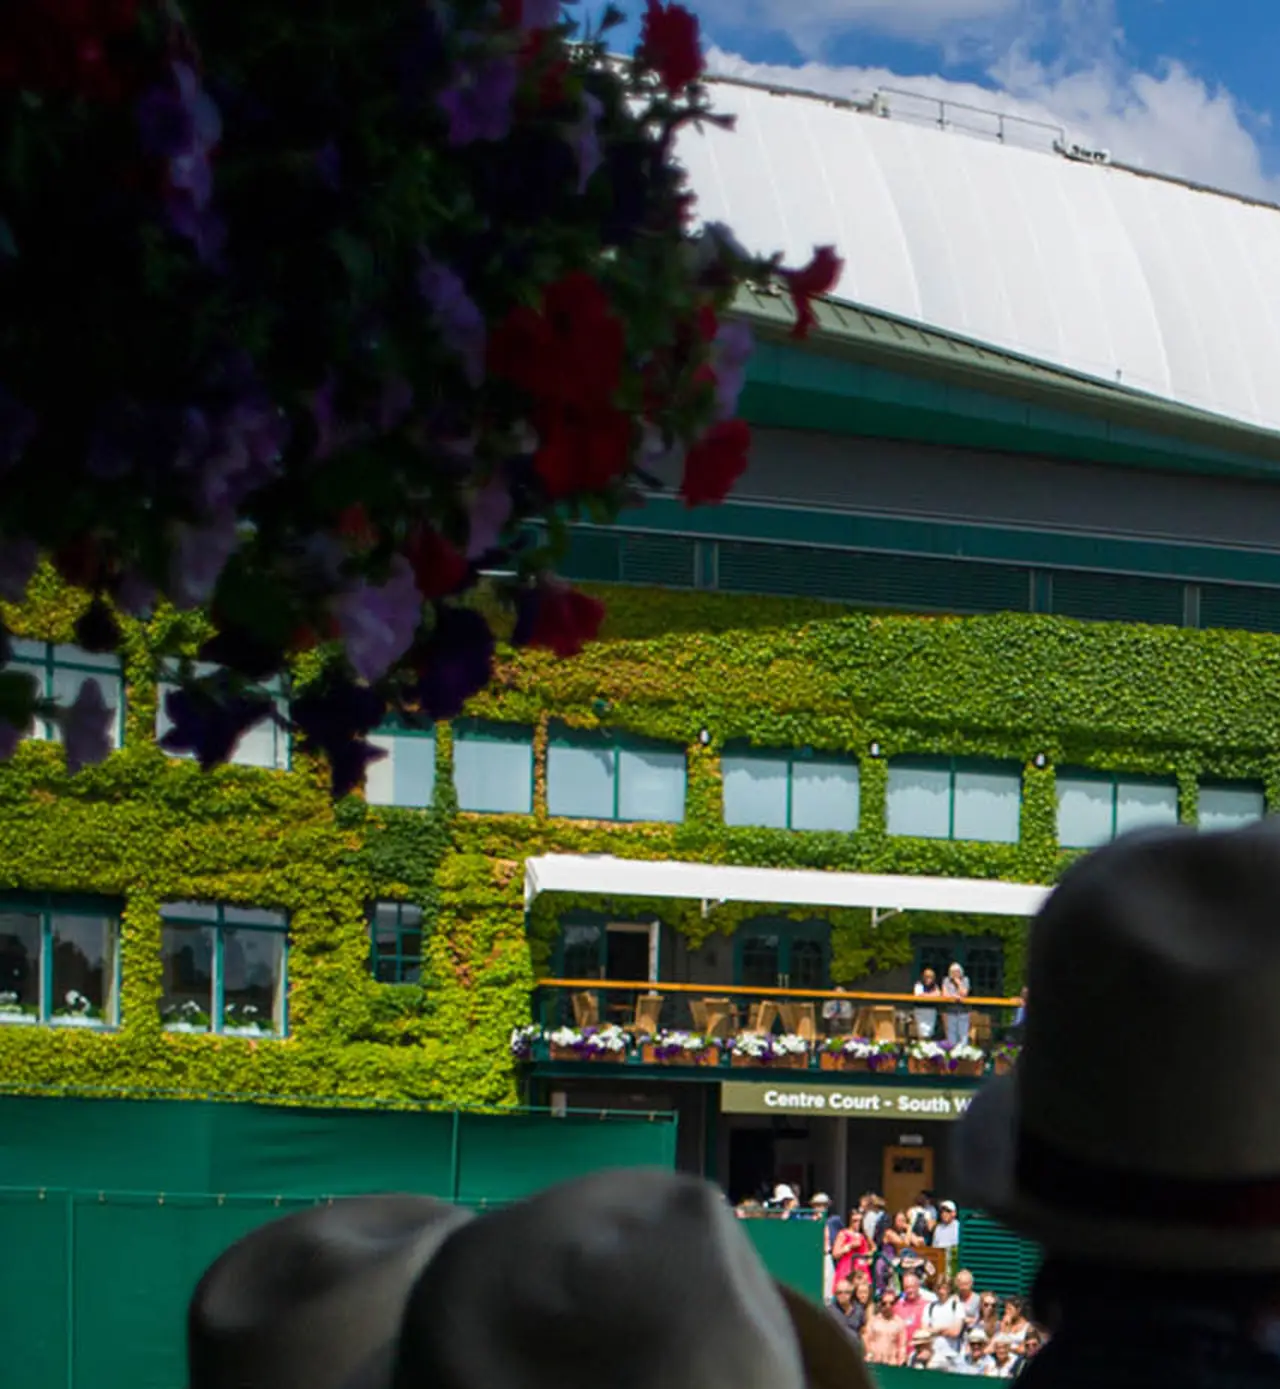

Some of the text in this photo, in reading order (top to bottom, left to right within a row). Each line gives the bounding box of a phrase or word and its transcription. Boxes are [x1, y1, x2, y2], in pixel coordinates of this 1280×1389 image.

[764, 1090, 826, 1108] Centre
[828, 1093, 880, 1110] Court
[897, 1095, 950, 1112] South
